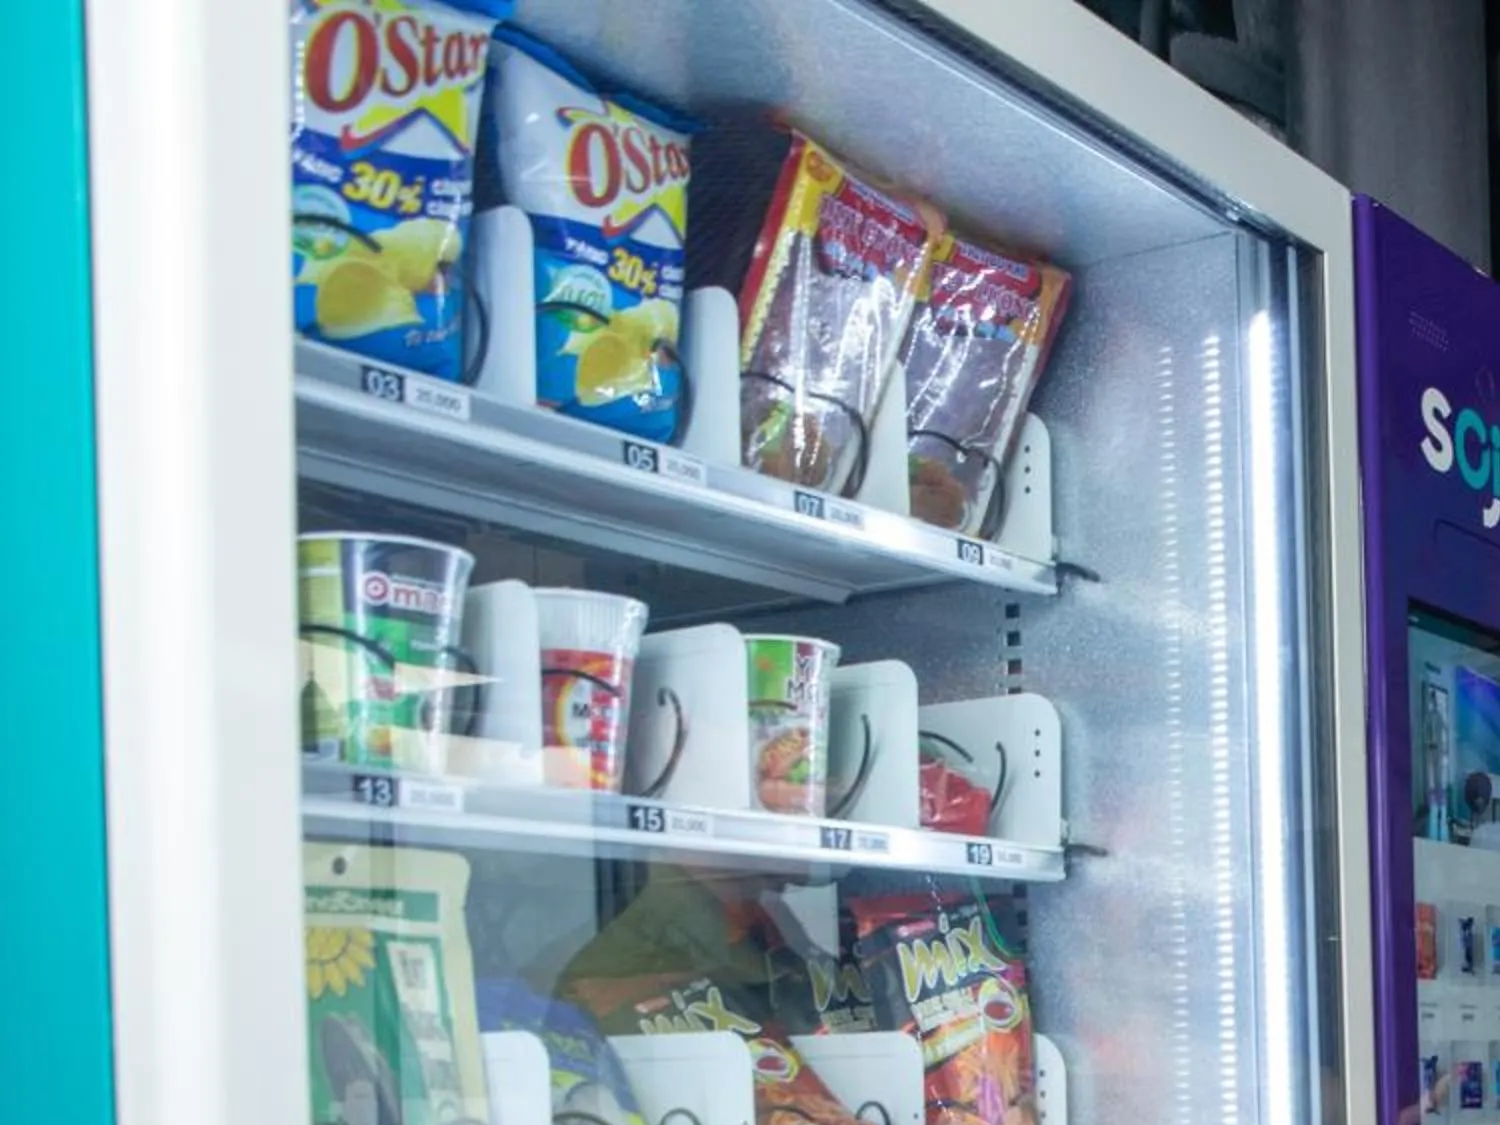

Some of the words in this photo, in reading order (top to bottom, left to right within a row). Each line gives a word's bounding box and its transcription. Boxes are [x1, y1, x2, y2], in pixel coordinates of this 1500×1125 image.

[343, 161, 424, 214] 30%
[608, 247, 657, 294] 30%
[366, 370, 400, 401] 03
[628, 445, 654, 471] 05
[799, 496, 820, 518] 07
[358, 778, 392, 805] 13
[634, 807, 661, 831] 15
[826, 830, 848, 849] 17
